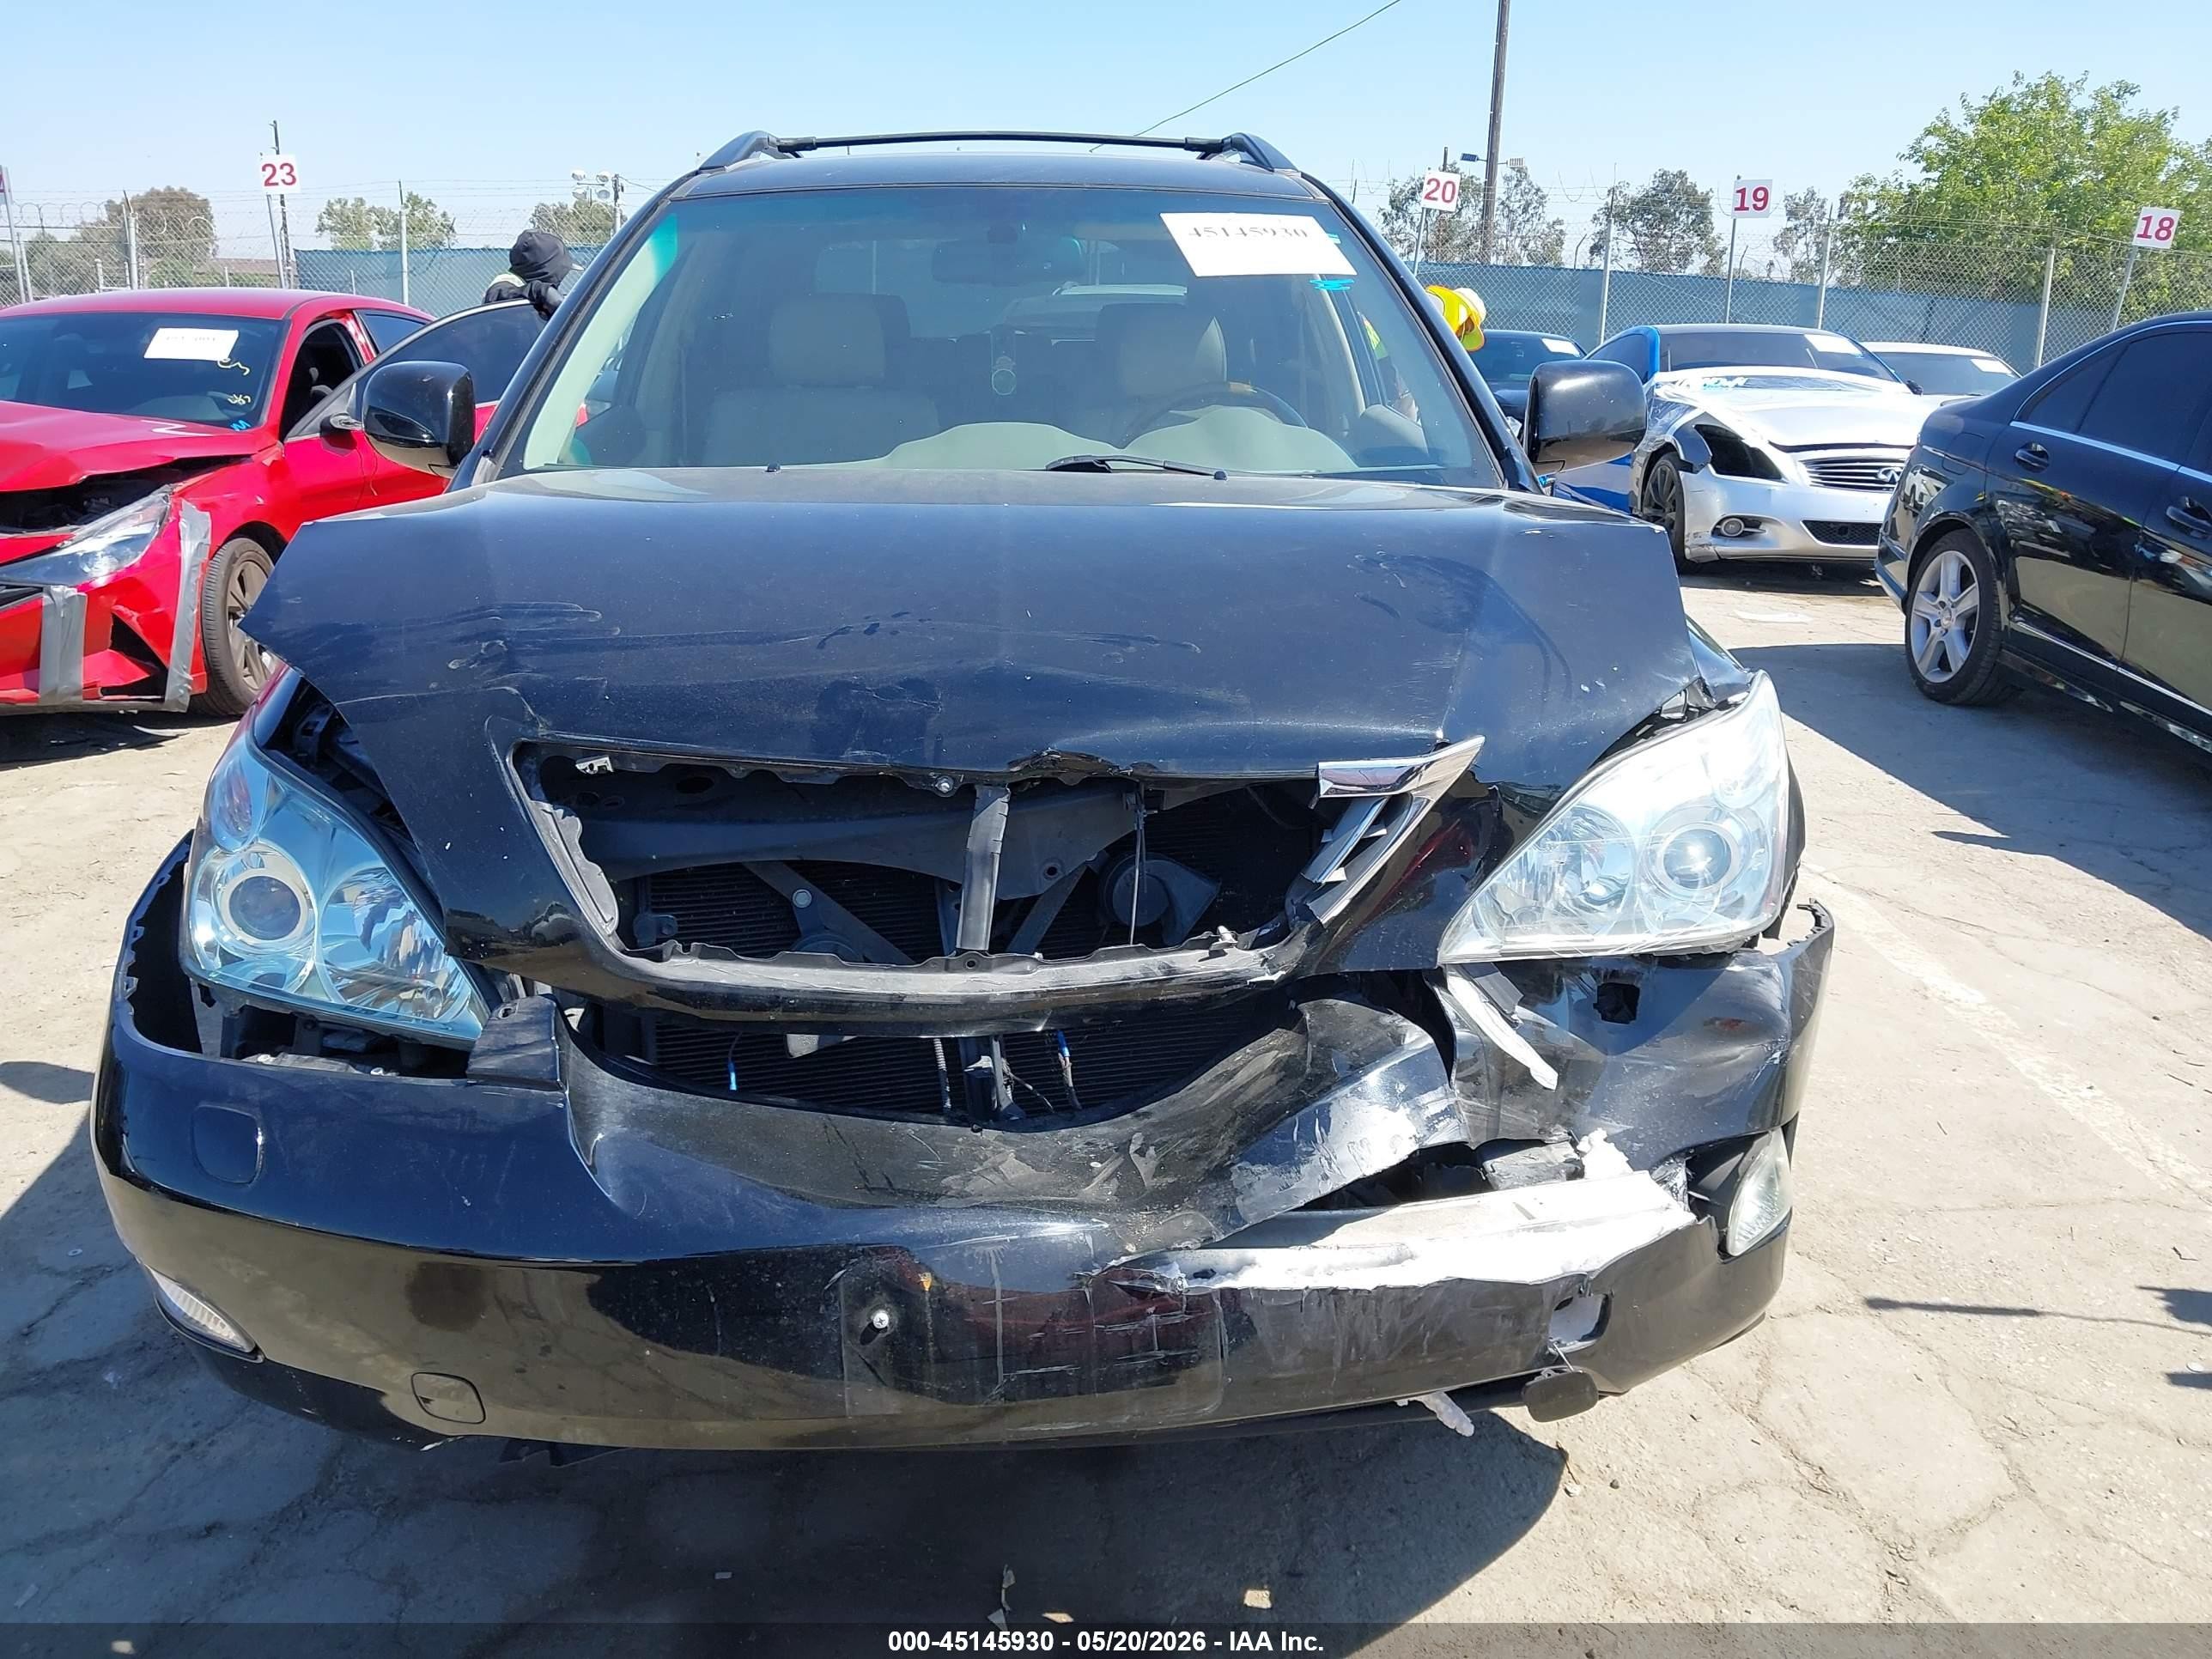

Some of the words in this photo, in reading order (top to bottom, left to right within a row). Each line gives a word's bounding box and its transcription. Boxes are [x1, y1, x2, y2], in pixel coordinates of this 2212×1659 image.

[261, 162, 297, 186] 23
[1424, 177, 1456, 204] 20
[1734, 186, 1769, 211] 19
[2136, 215, 2175, 241] 18
